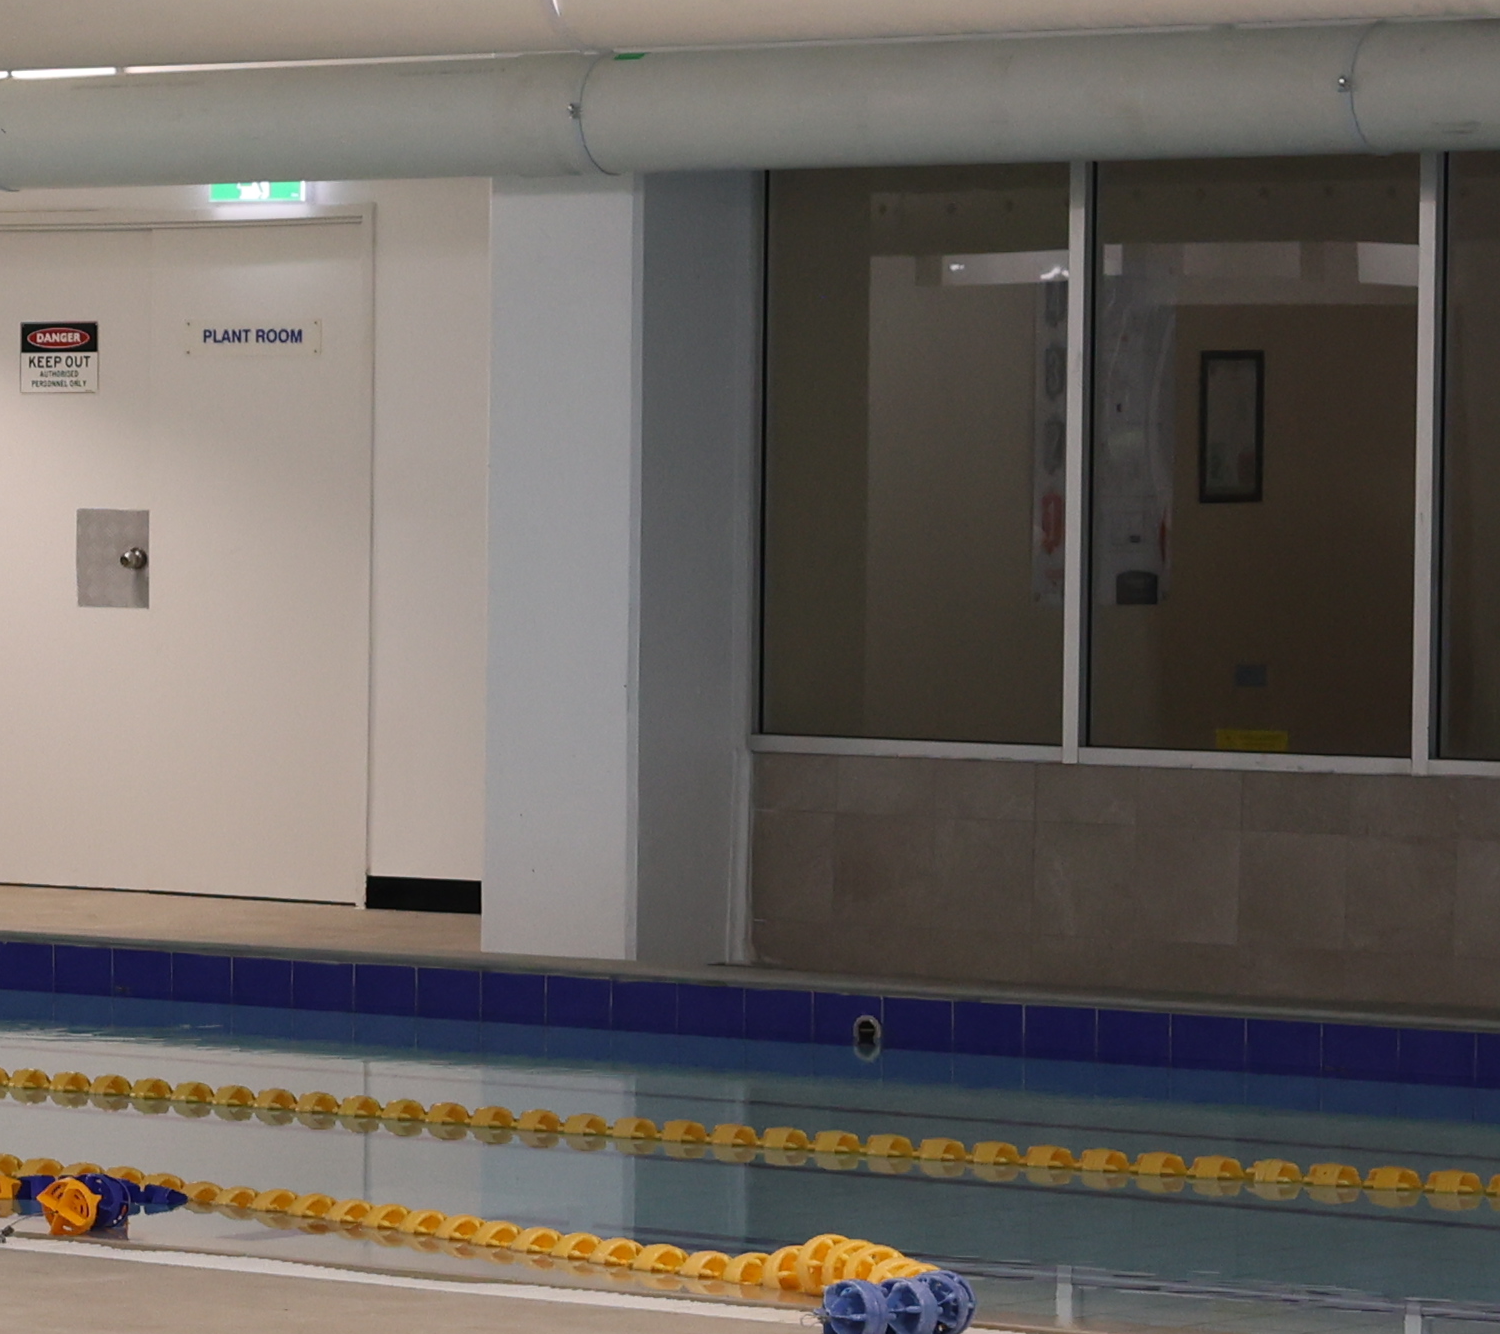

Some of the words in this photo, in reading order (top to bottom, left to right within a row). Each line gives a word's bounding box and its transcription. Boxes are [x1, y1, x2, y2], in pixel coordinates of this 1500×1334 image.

[36, 332, 82, 343] DANGER
[203, 328, 251, 344] PLANT
[255, 328, 303, 344] ROOM
[28, 355, 62, 368] KEEP
[65, 355, 91, 368] OUT
[40, 370, 79, 378] AUTHORISED
[31, 379, 68, 387] PERSONNEL
[69, 379, 87, 387] ONLY
